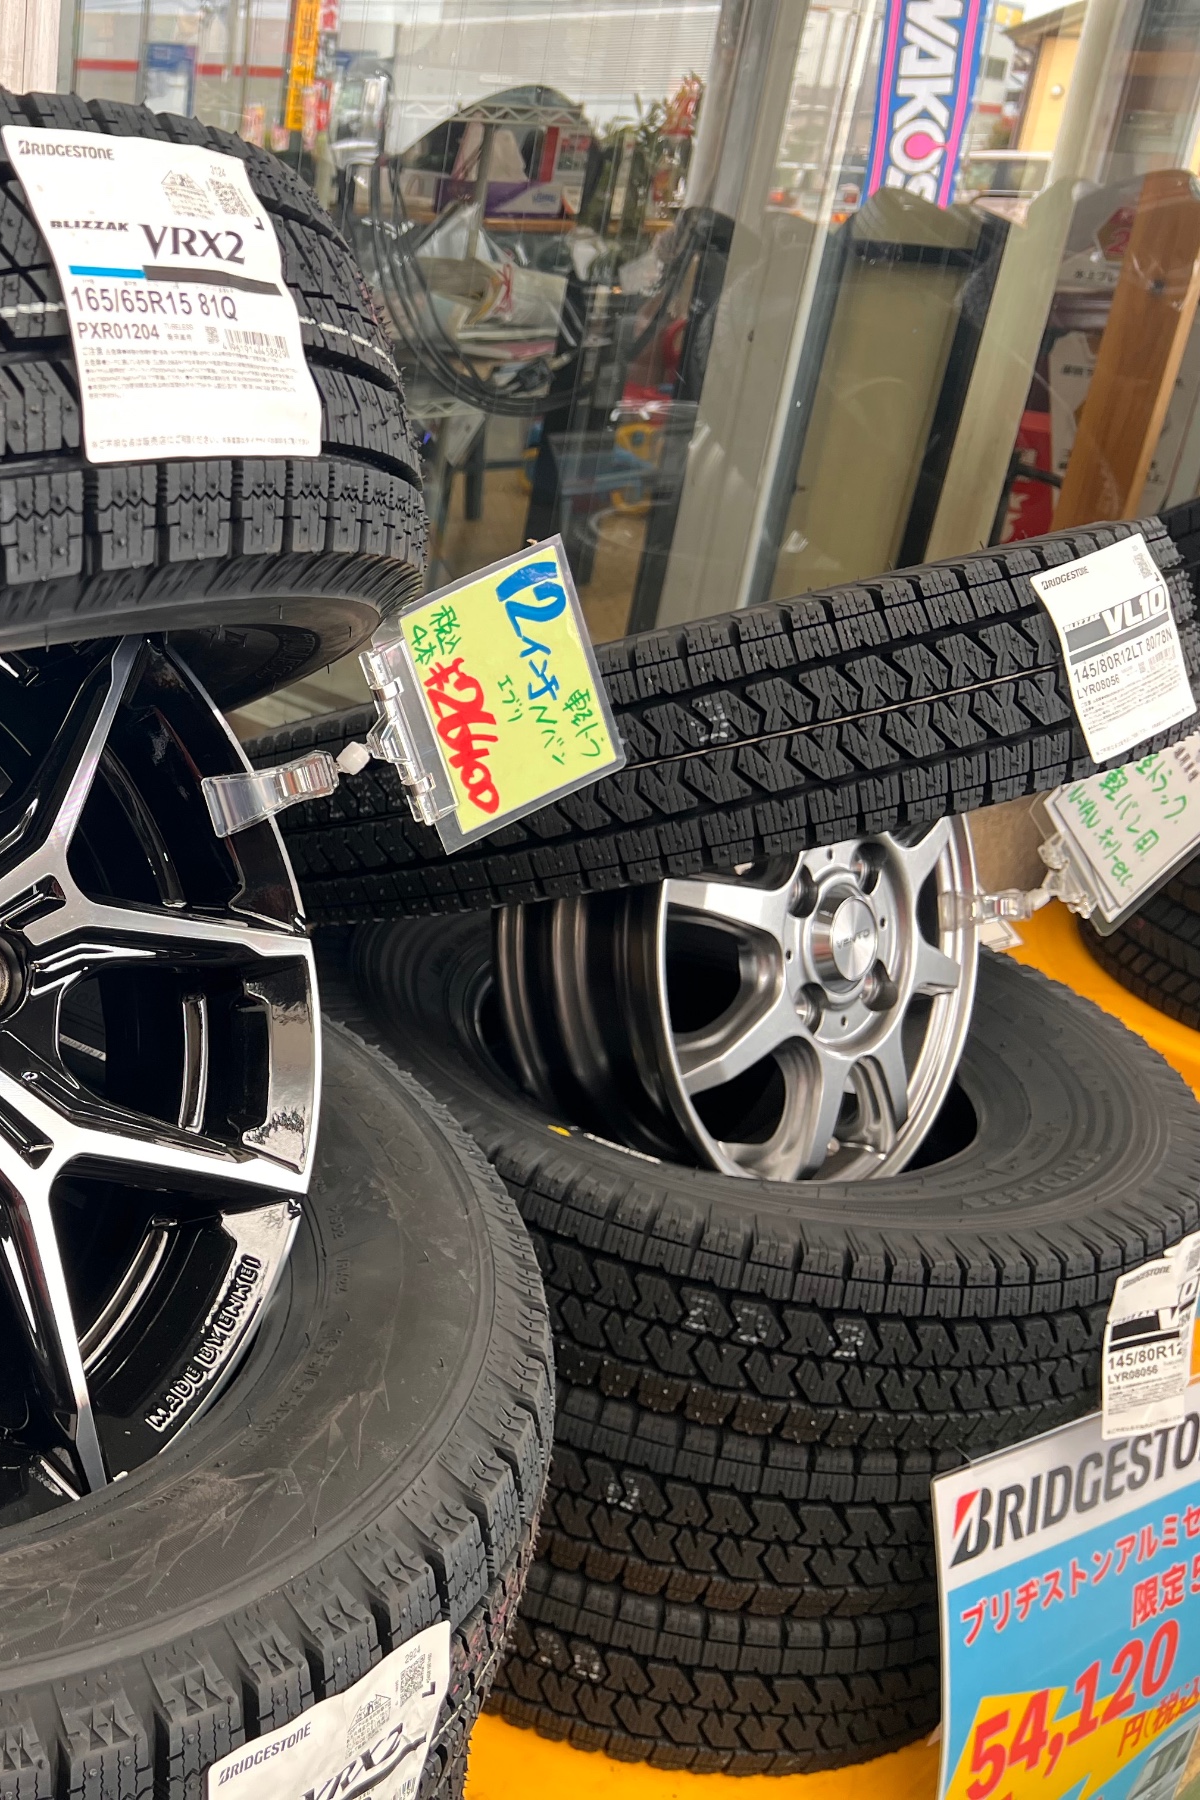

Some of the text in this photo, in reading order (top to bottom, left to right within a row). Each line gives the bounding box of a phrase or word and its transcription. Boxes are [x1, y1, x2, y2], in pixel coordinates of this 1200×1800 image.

[18, 140, 115, 161] BRIDGESTONE
[50, 219, 246, 265] BLIZZAK VRX2
[70, 286, 239, 322] 165/65R15 81Q
[76, 322, 160, 340] PXR01204
[1041, 565, 1090, 590] BRIDGESTONE
[429, 604, 462, 655] 税込
[495, 561, 567, 701] 12インチ
[1101, 583, 1167, 637] VL10
[412, 624, 437, 665] 4本
[1073, 626, 1173, 684] 145/80R12LT 80/78N
[497, 674, 524, 723] エブリ
[1076, 673, 1120, 700] LYR08056
[528, 705, 566, 766] Nバン
[562, 688, 601, 758] 軽トラ
[144, 1365, 208, 1433] MADE
[209, 1253, 262, 1337] ENKEI
[1107, 1364, 1158, 1386] LYR08056
[966, 1618, 1180, 1800] 54,120
[218, 1721, 312, 1786] BRIDGESTONE
